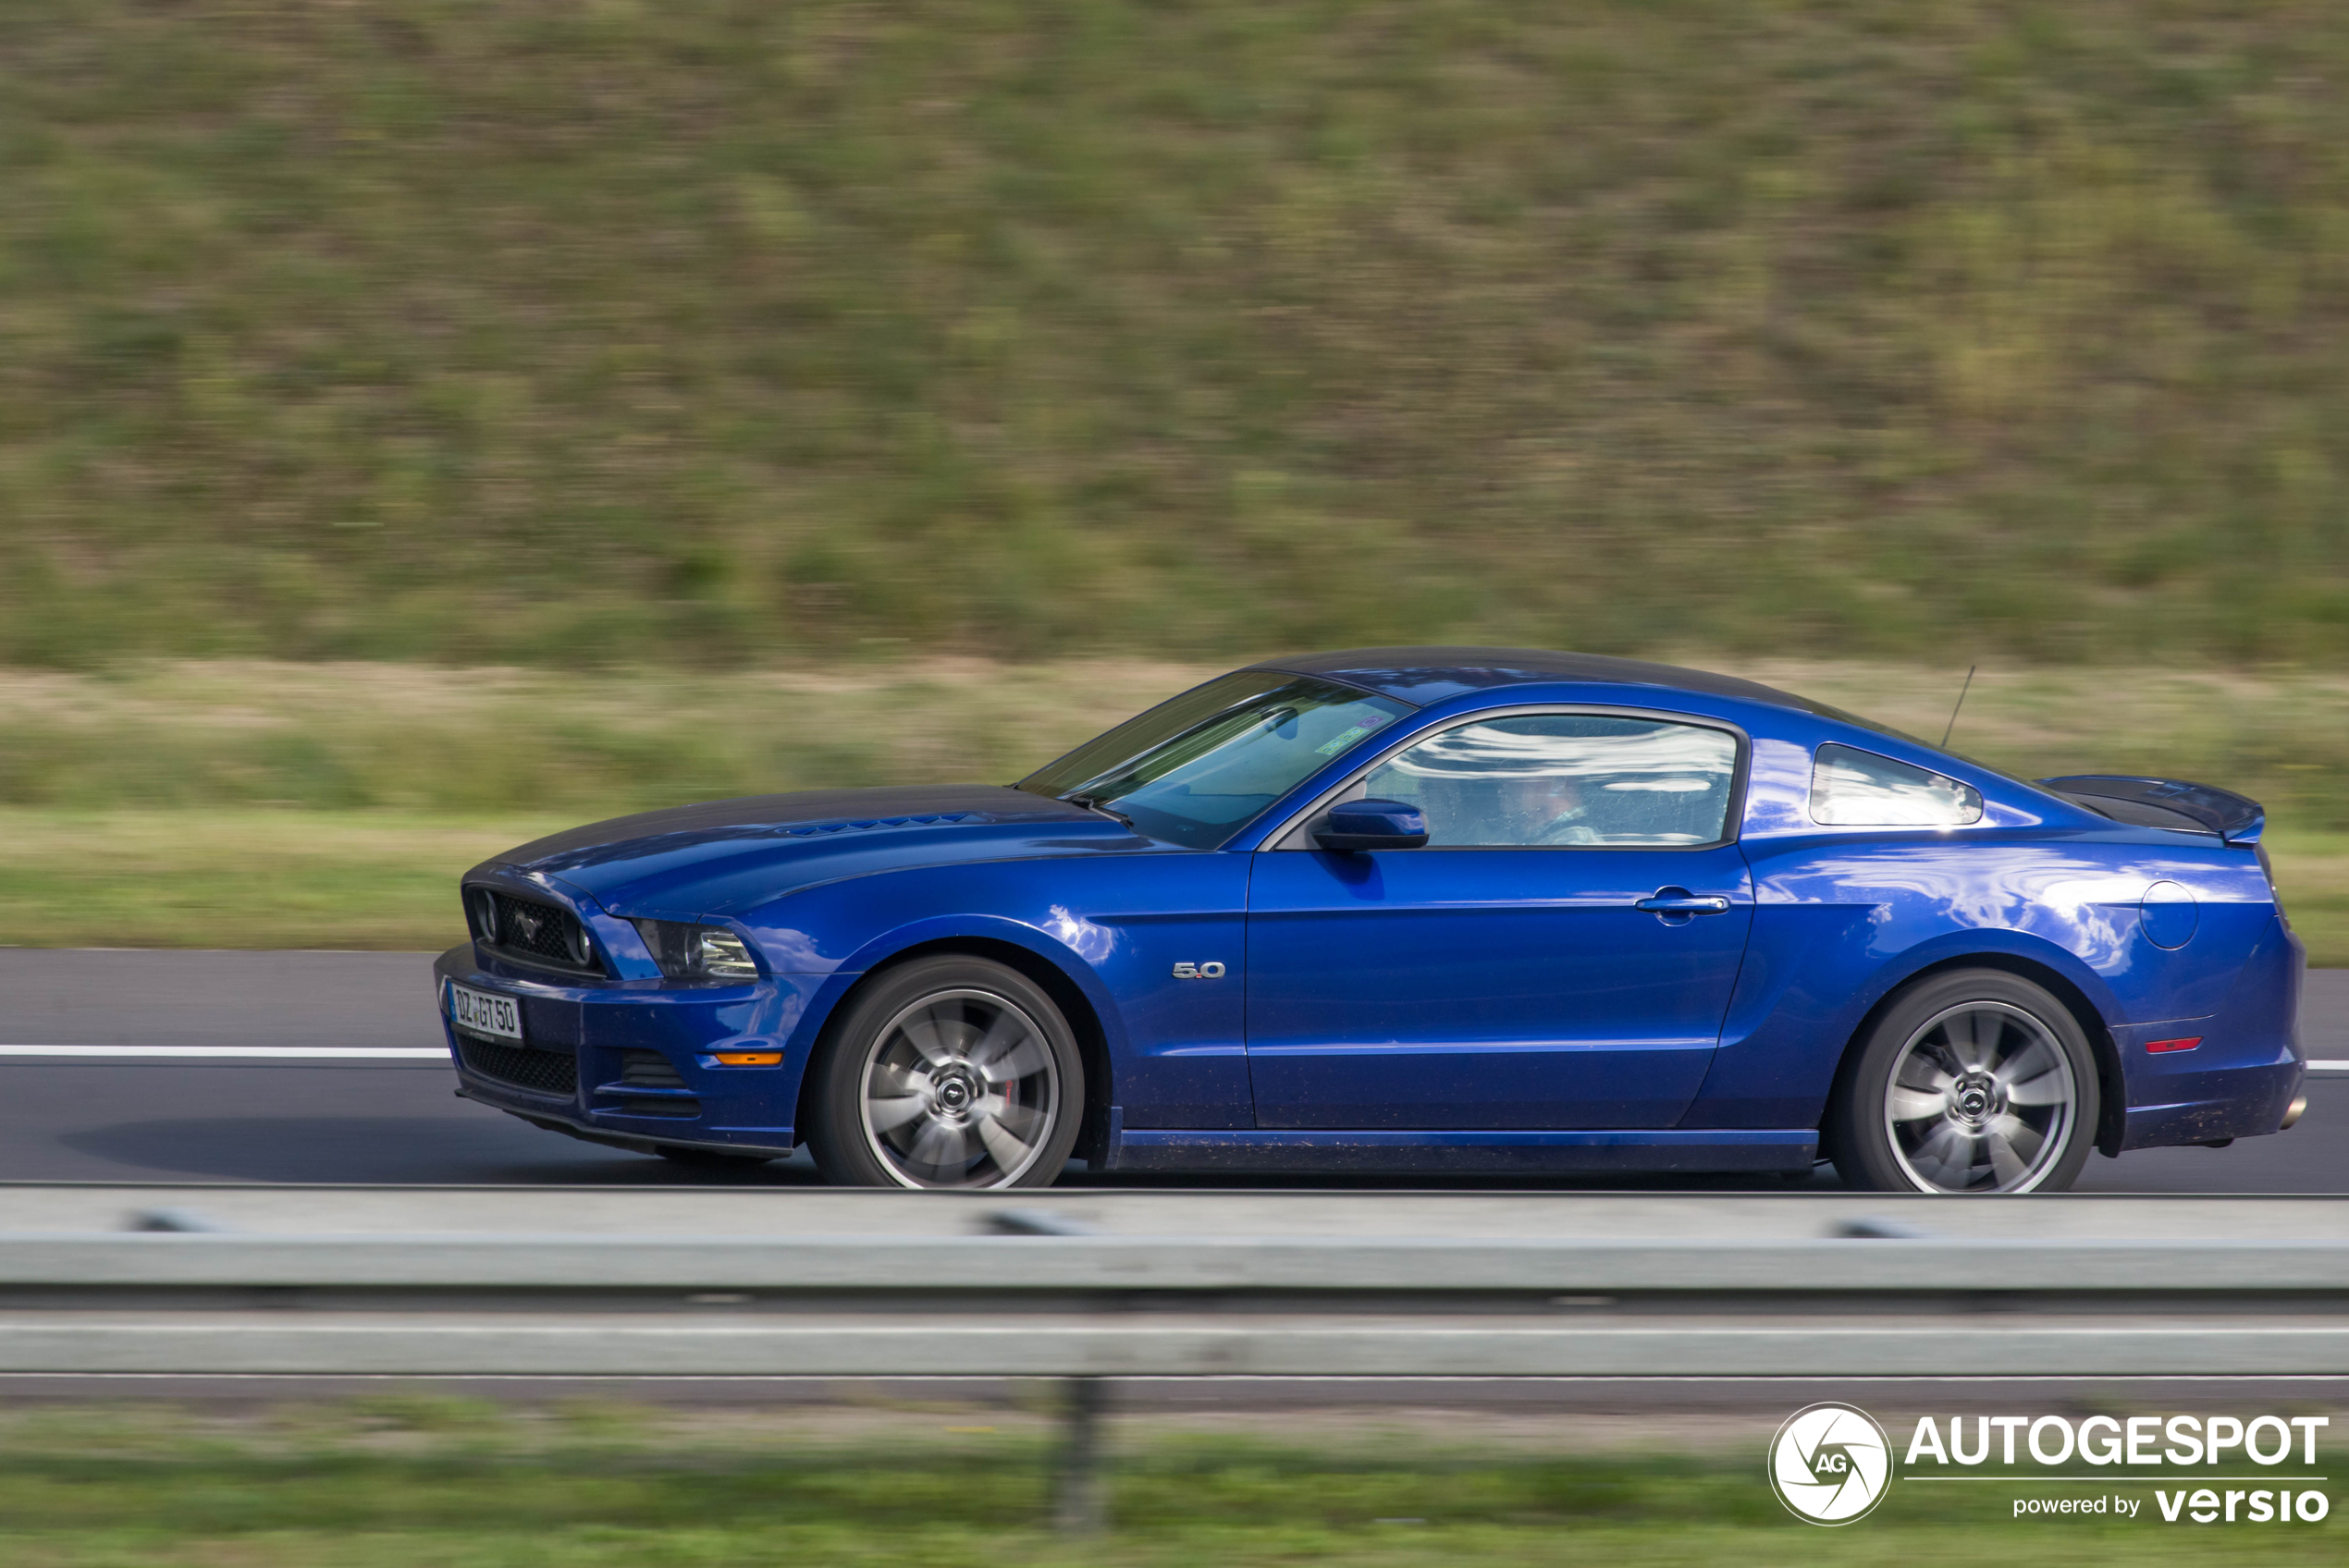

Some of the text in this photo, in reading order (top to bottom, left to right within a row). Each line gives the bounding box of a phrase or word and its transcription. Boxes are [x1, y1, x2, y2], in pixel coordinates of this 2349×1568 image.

[1172, 962, 1226, 979] 5.0
[456, 989, 515, 1033] DZ GT 50
